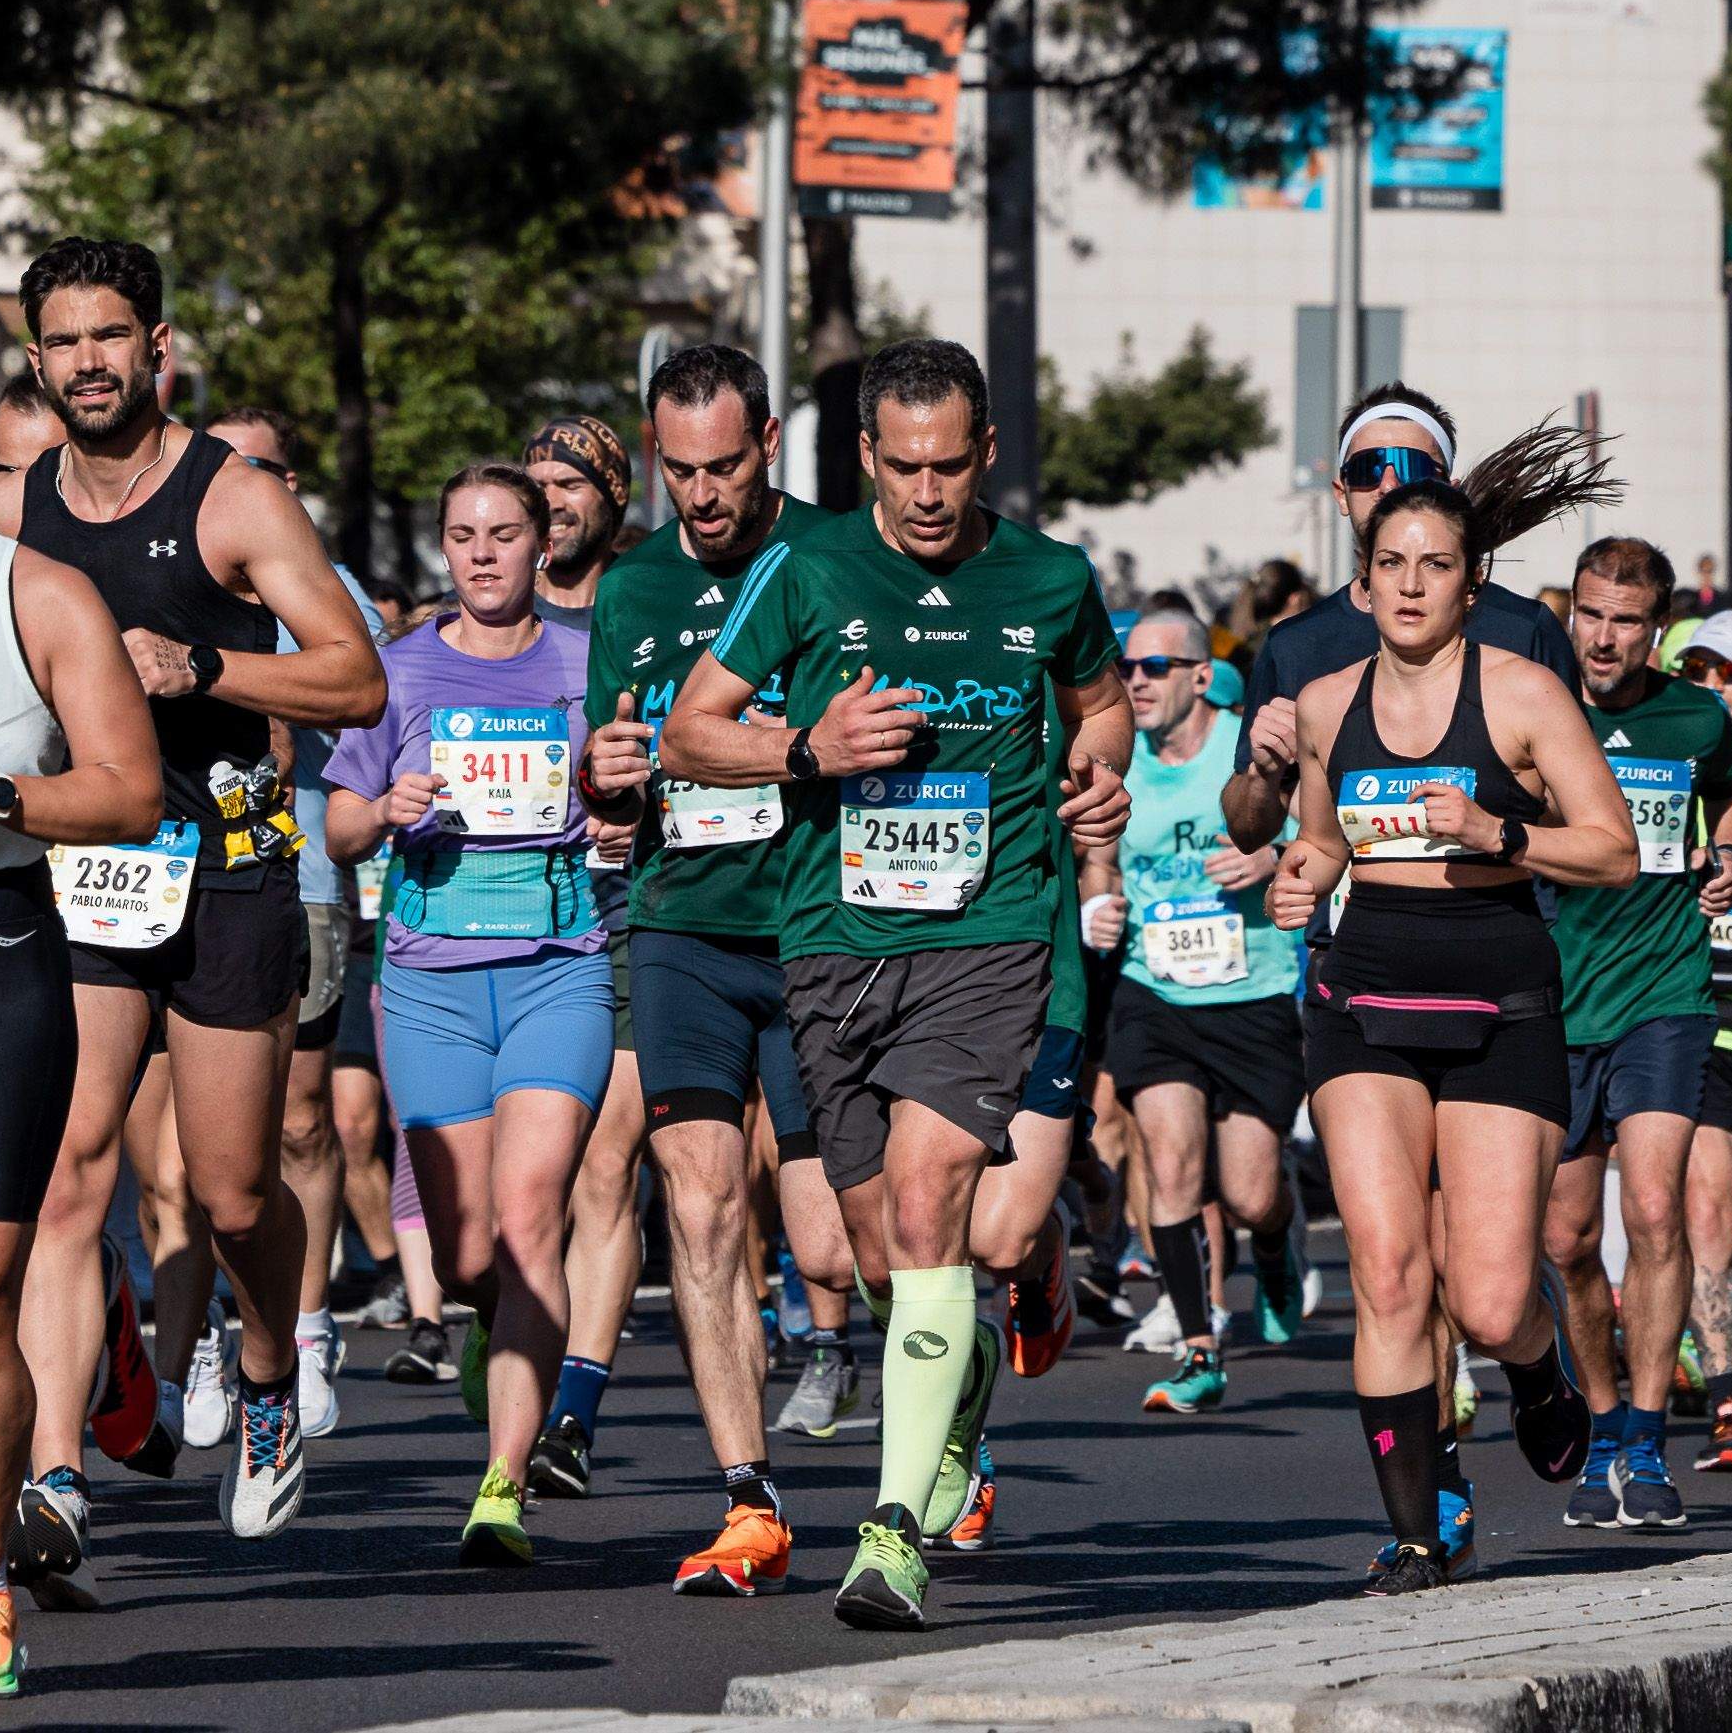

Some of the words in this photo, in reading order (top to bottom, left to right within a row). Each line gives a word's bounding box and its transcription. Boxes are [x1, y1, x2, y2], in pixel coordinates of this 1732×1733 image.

[697, 629, 720, 640] ZUR
[924, 631, 968, 641] ZURICH
[481, 718, 547, 733] ZURICH
[938, 722, 993, 731] MARATHON
[462, 753, 529, 783] 3411
[1617, 766, 1673, 782] ZURICH
[488, 788, 513, 800] KAIA
[894, 784, 966, 799] ZURICH
[864, 818, 959, 854] 25445
[889, 859, 938, 872] ANTONIO
[74, 857, 152, 894] 2362
[70, 894, 103, 908] PABLO
[105, 897, 150, 913] MARTOS
[483, 922, 533, 932] RAIDLIGHT
[1168, 928, 1215, 951] 3841
